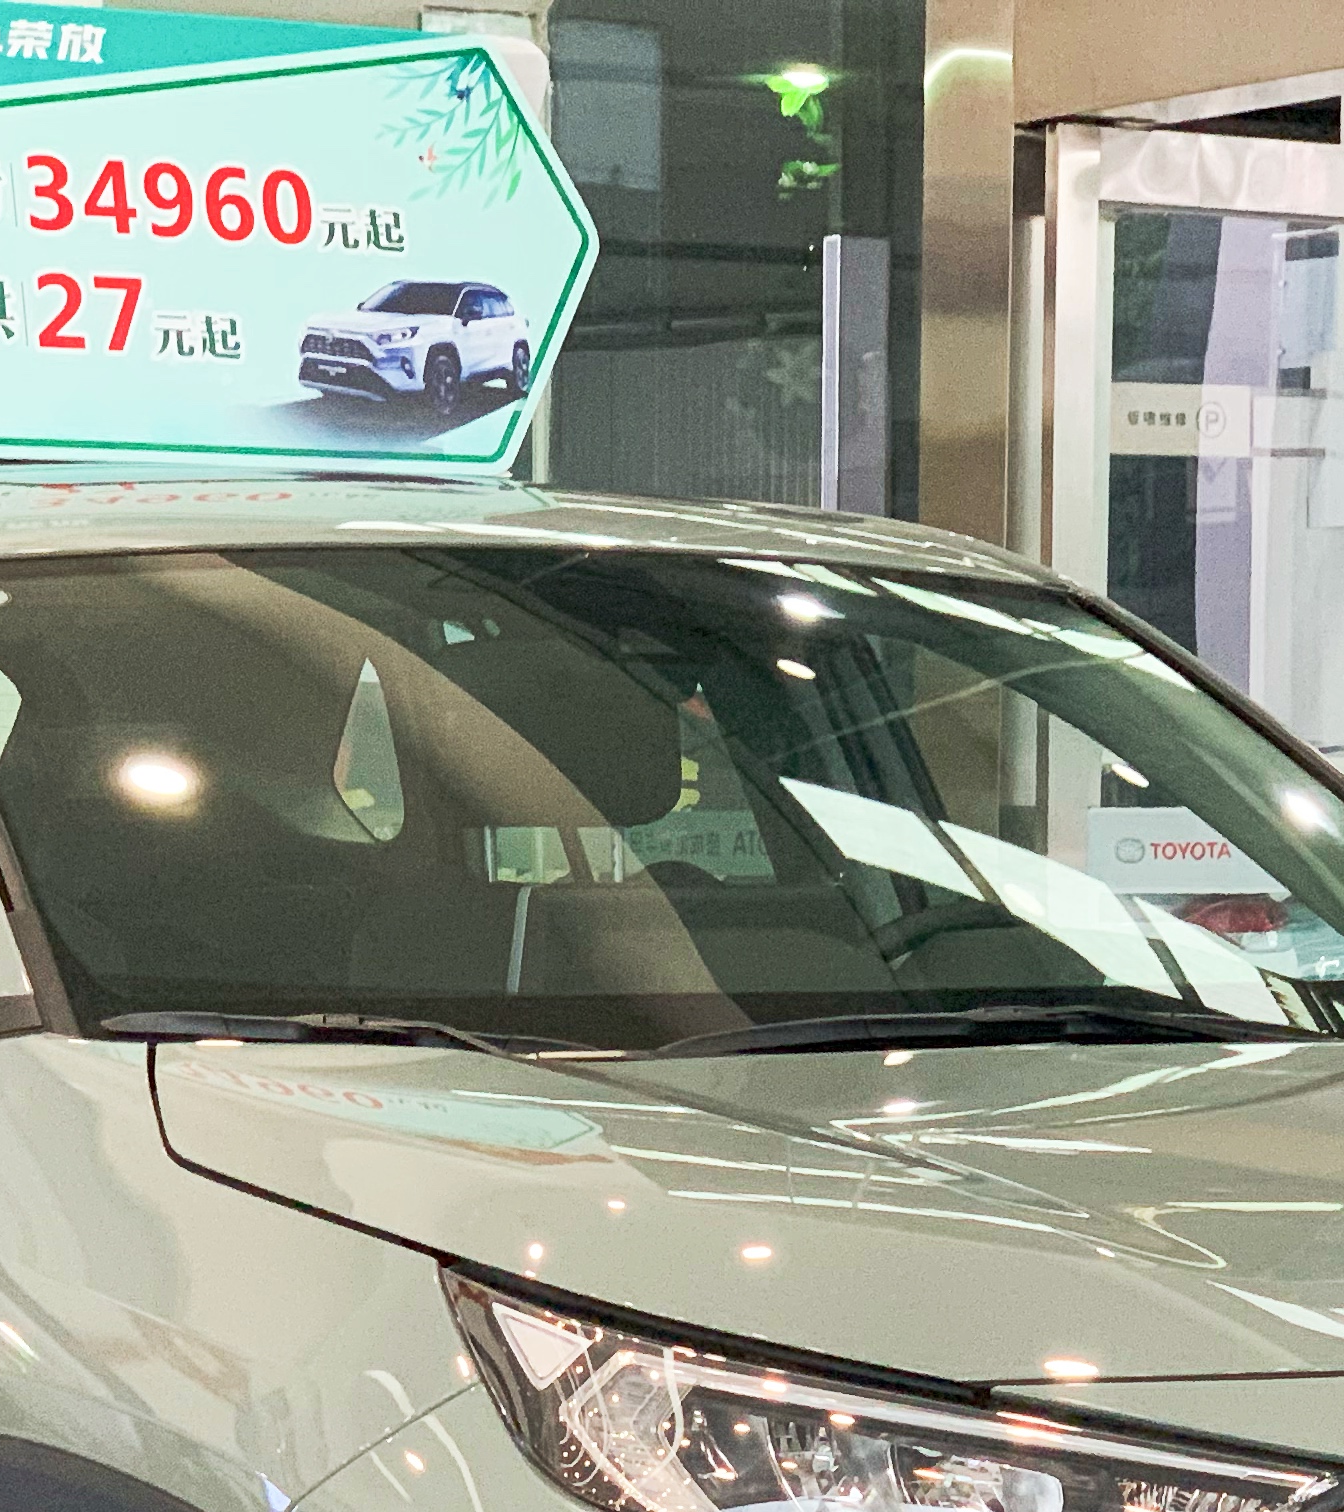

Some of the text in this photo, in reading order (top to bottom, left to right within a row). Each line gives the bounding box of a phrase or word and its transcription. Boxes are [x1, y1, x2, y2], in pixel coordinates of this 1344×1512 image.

[27, 154, 405, 253] 34960元起
[36, 271, 242, 360] 27元起
[1150, 841, 1232, 861] TOYOTA
